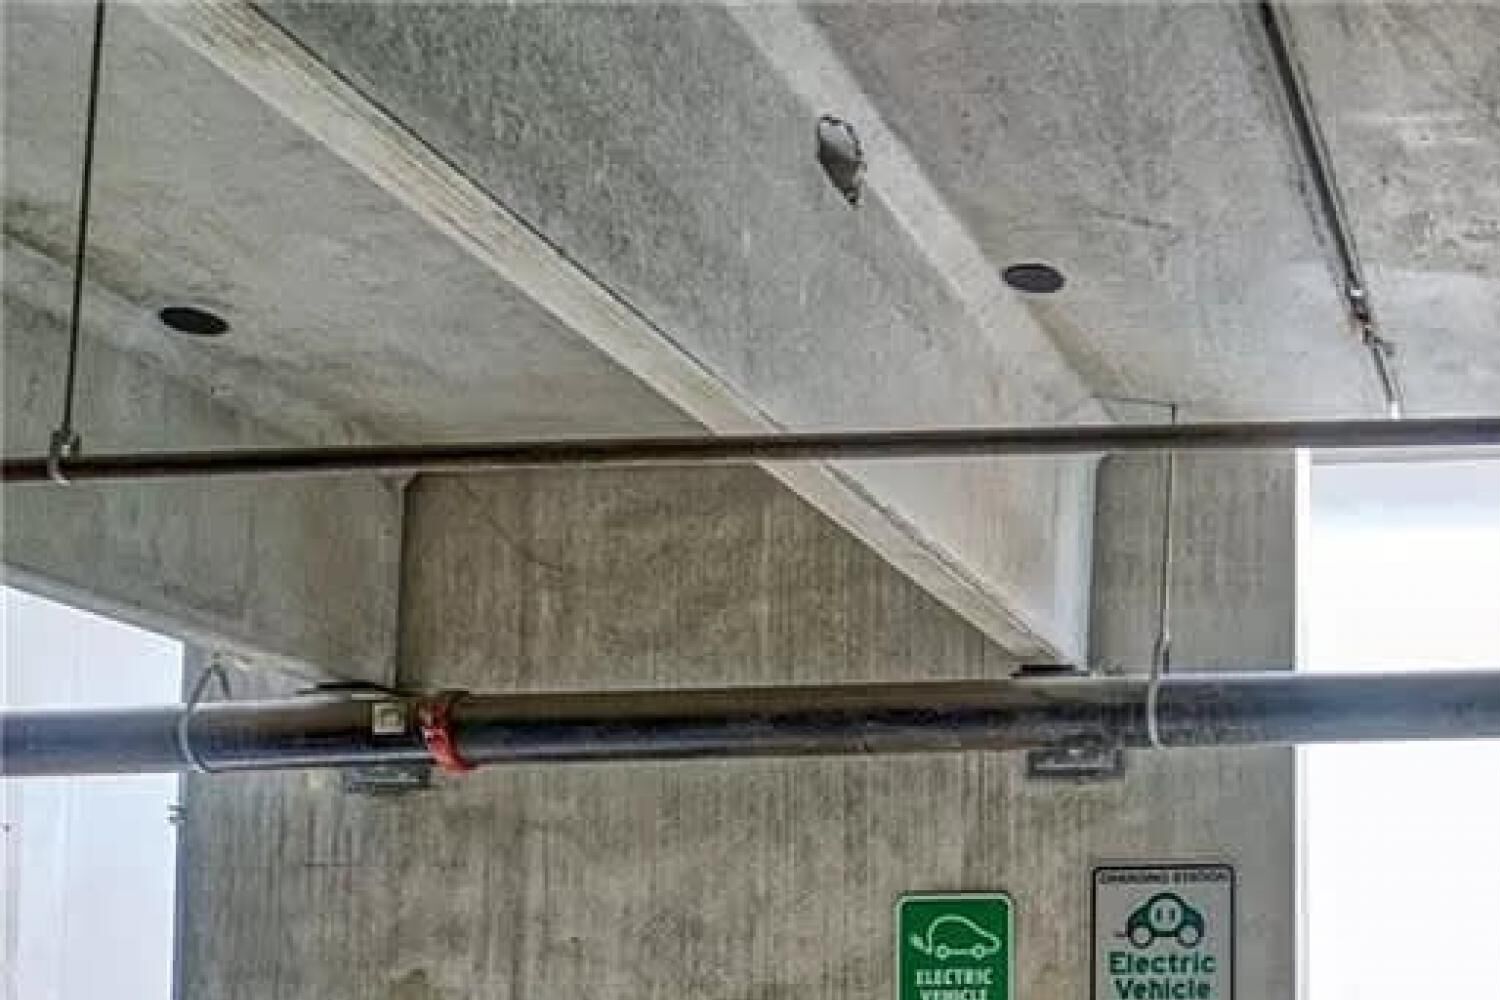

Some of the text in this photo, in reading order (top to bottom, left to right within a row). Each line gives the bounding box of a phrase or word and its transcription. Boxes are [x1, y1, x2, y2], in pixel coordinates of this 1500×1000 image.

[1109, 951, 1217, 974] Electric
[916, 968, 993, 985] ELECTRIC
[1113, 979, 1211, 1000] Vehicle
